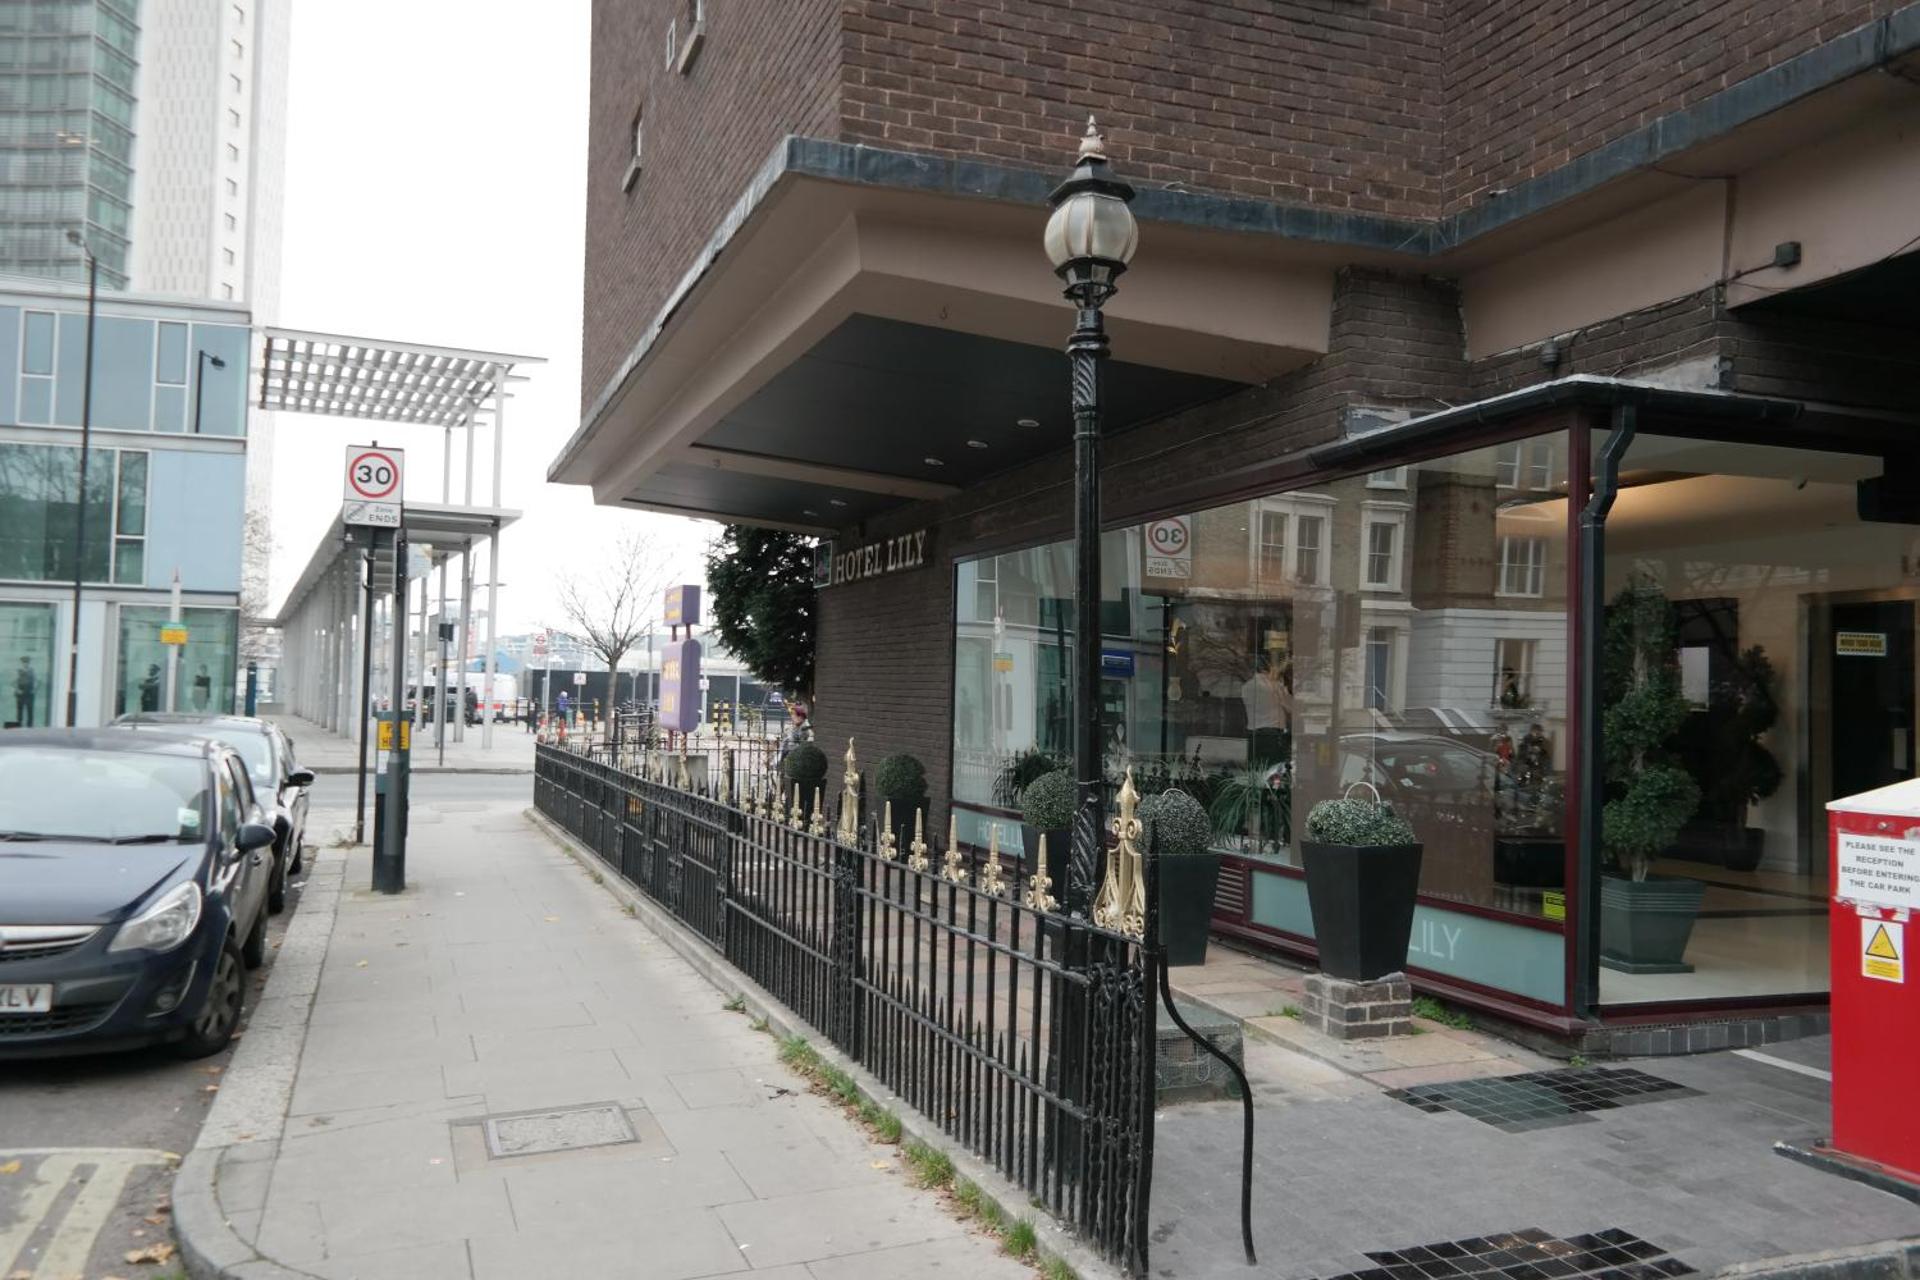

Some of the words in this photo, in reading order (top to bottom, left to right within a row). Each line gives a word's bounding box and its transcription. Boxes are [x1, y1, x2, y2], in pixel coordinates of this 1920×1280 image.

[357, 465, 391, 485] 30
[369, 514, 398, 523] ENDS
[834, 542, 882, 584] HOTEL
[886, 529, 926, 572] LILY
[976, 820, 1009, 846] HOEL
[1846, 841, 1876, 851] PLEASE
[1879, 845, 1895, 853] SEE
[1898, 847, 1916, 855] THE
[1856, 855, 1904, 867] RECEPTION
[1841, 866, 1873, 876] BEFORE
[1876, 870, 1920, 882] ENTERING
[1849, 879, 1865, 888] THE
[1868, 882, 1885, 890] CAR
[1887, 884, 1911, 893] PARK
